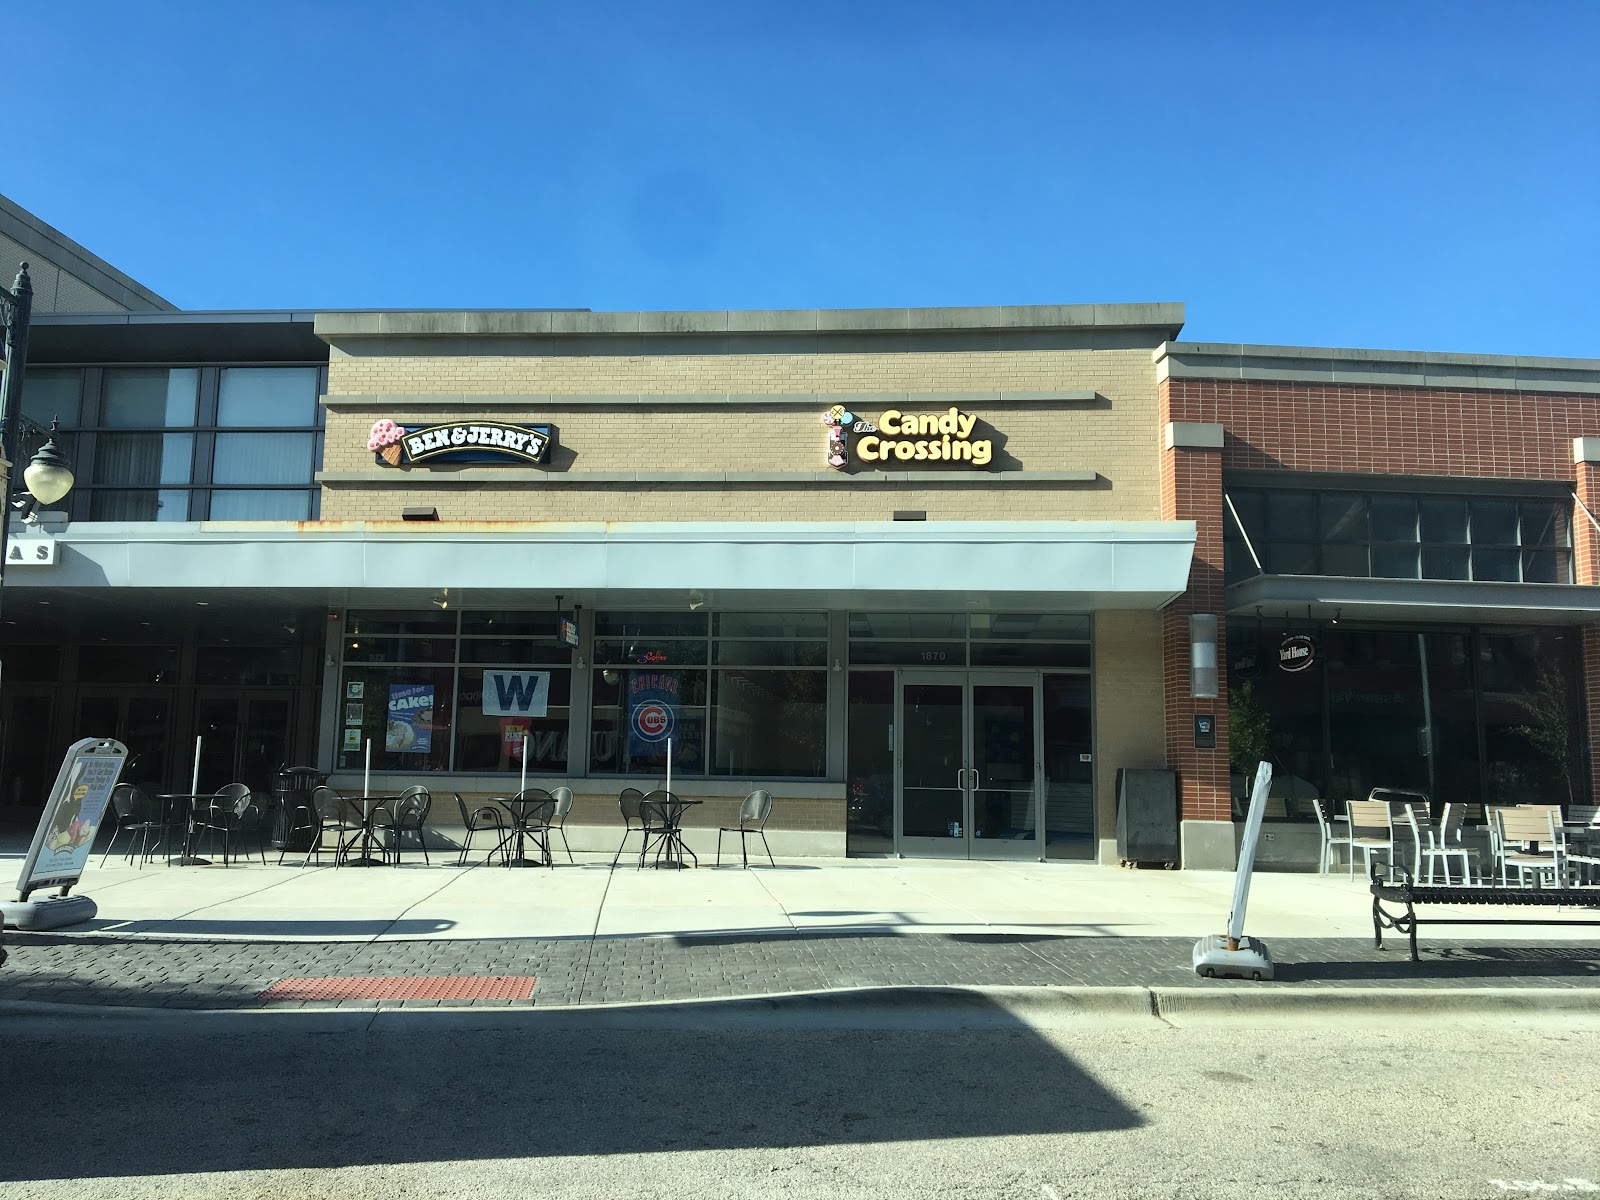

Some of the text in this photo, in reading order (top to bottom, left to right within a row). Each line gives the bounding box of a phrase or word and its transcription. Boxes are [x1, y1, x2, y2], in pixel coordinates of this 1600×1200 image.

[853, 407, 977, 439] The Candy
[856, 435, 992, 466] Crossing
[920, 651, 946, 661] 1870
[1291, 645, 1309, 659] House
[391, 686, 425, 700] time for
[493, 674, 539, 711] W
[631, 674, 679, 694] CHICAGO
